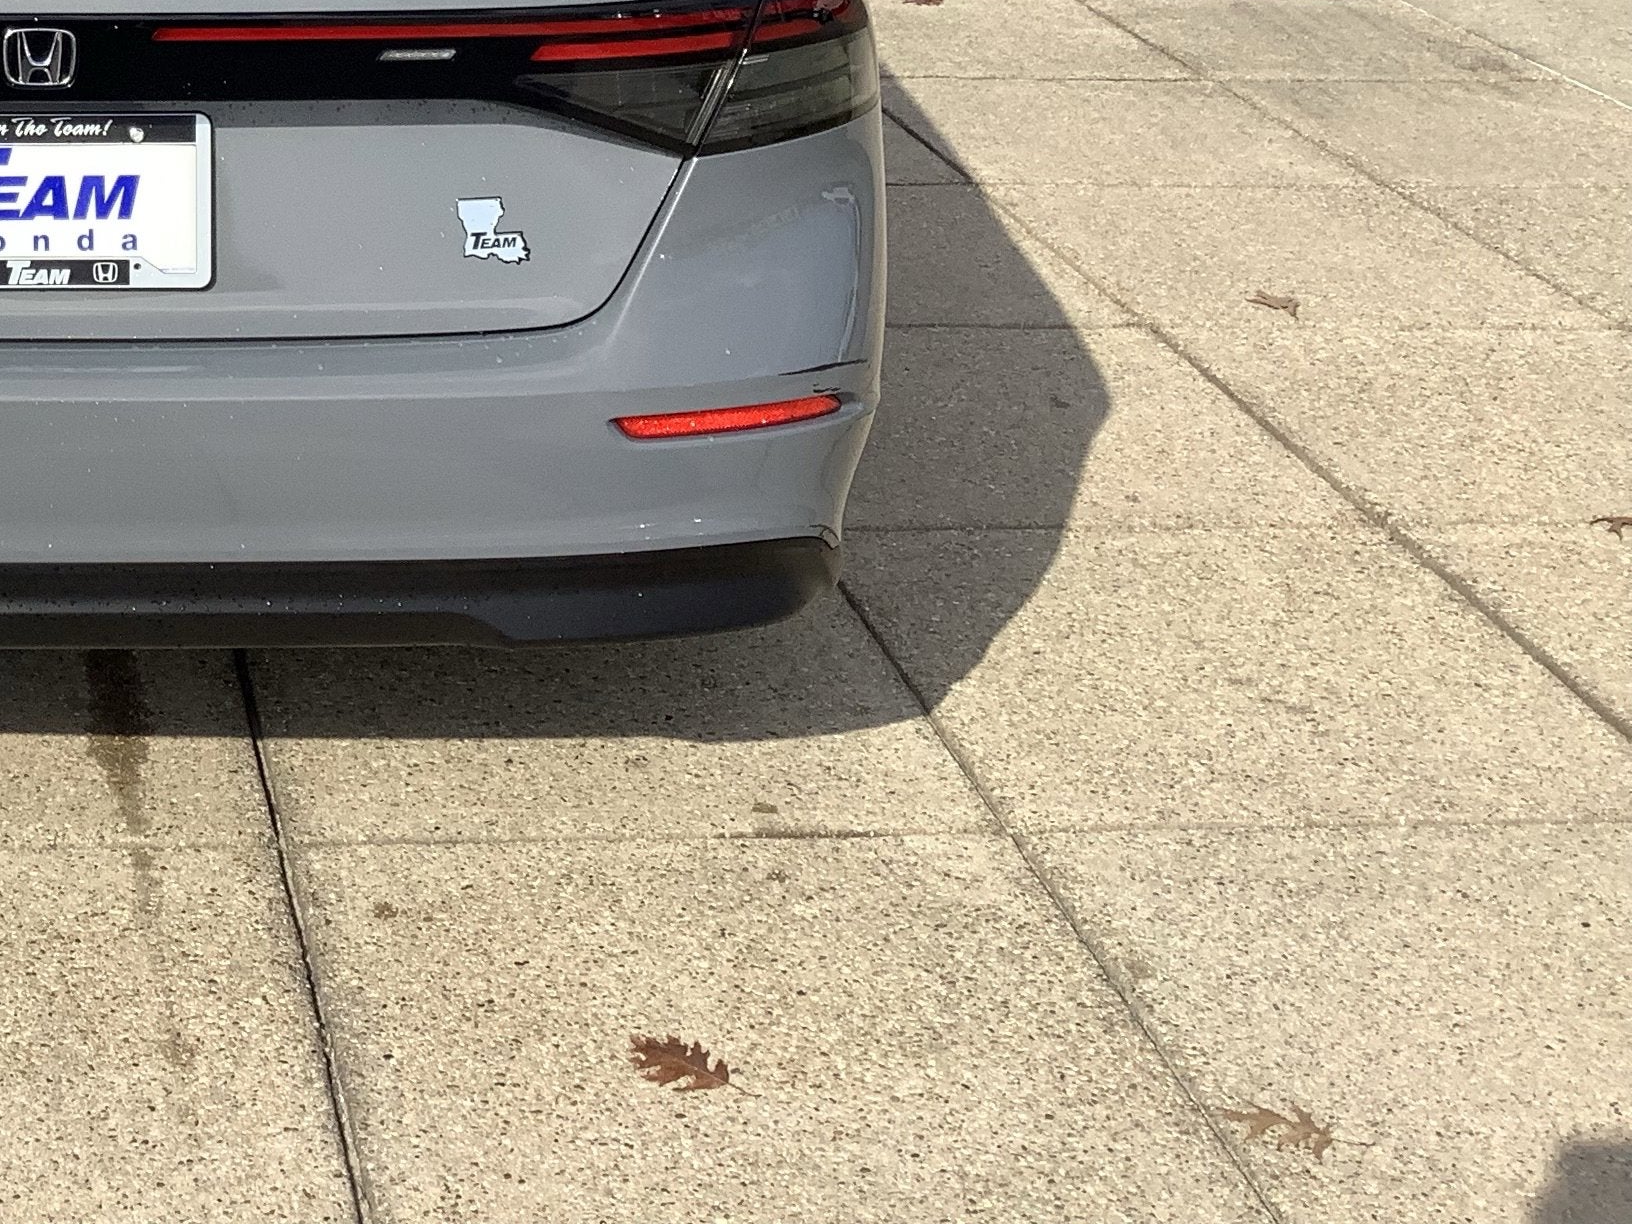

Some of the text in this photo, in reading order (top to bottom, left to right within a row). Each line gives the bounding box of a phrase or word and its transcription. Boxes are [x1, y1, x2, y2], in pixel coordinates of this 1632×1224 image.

[12, 117, 48, 137] The
[50, 117, 114, 138] Team!
[470, 232, 517, 250] TEAM
[5, 260, 70, 285] TEAM
